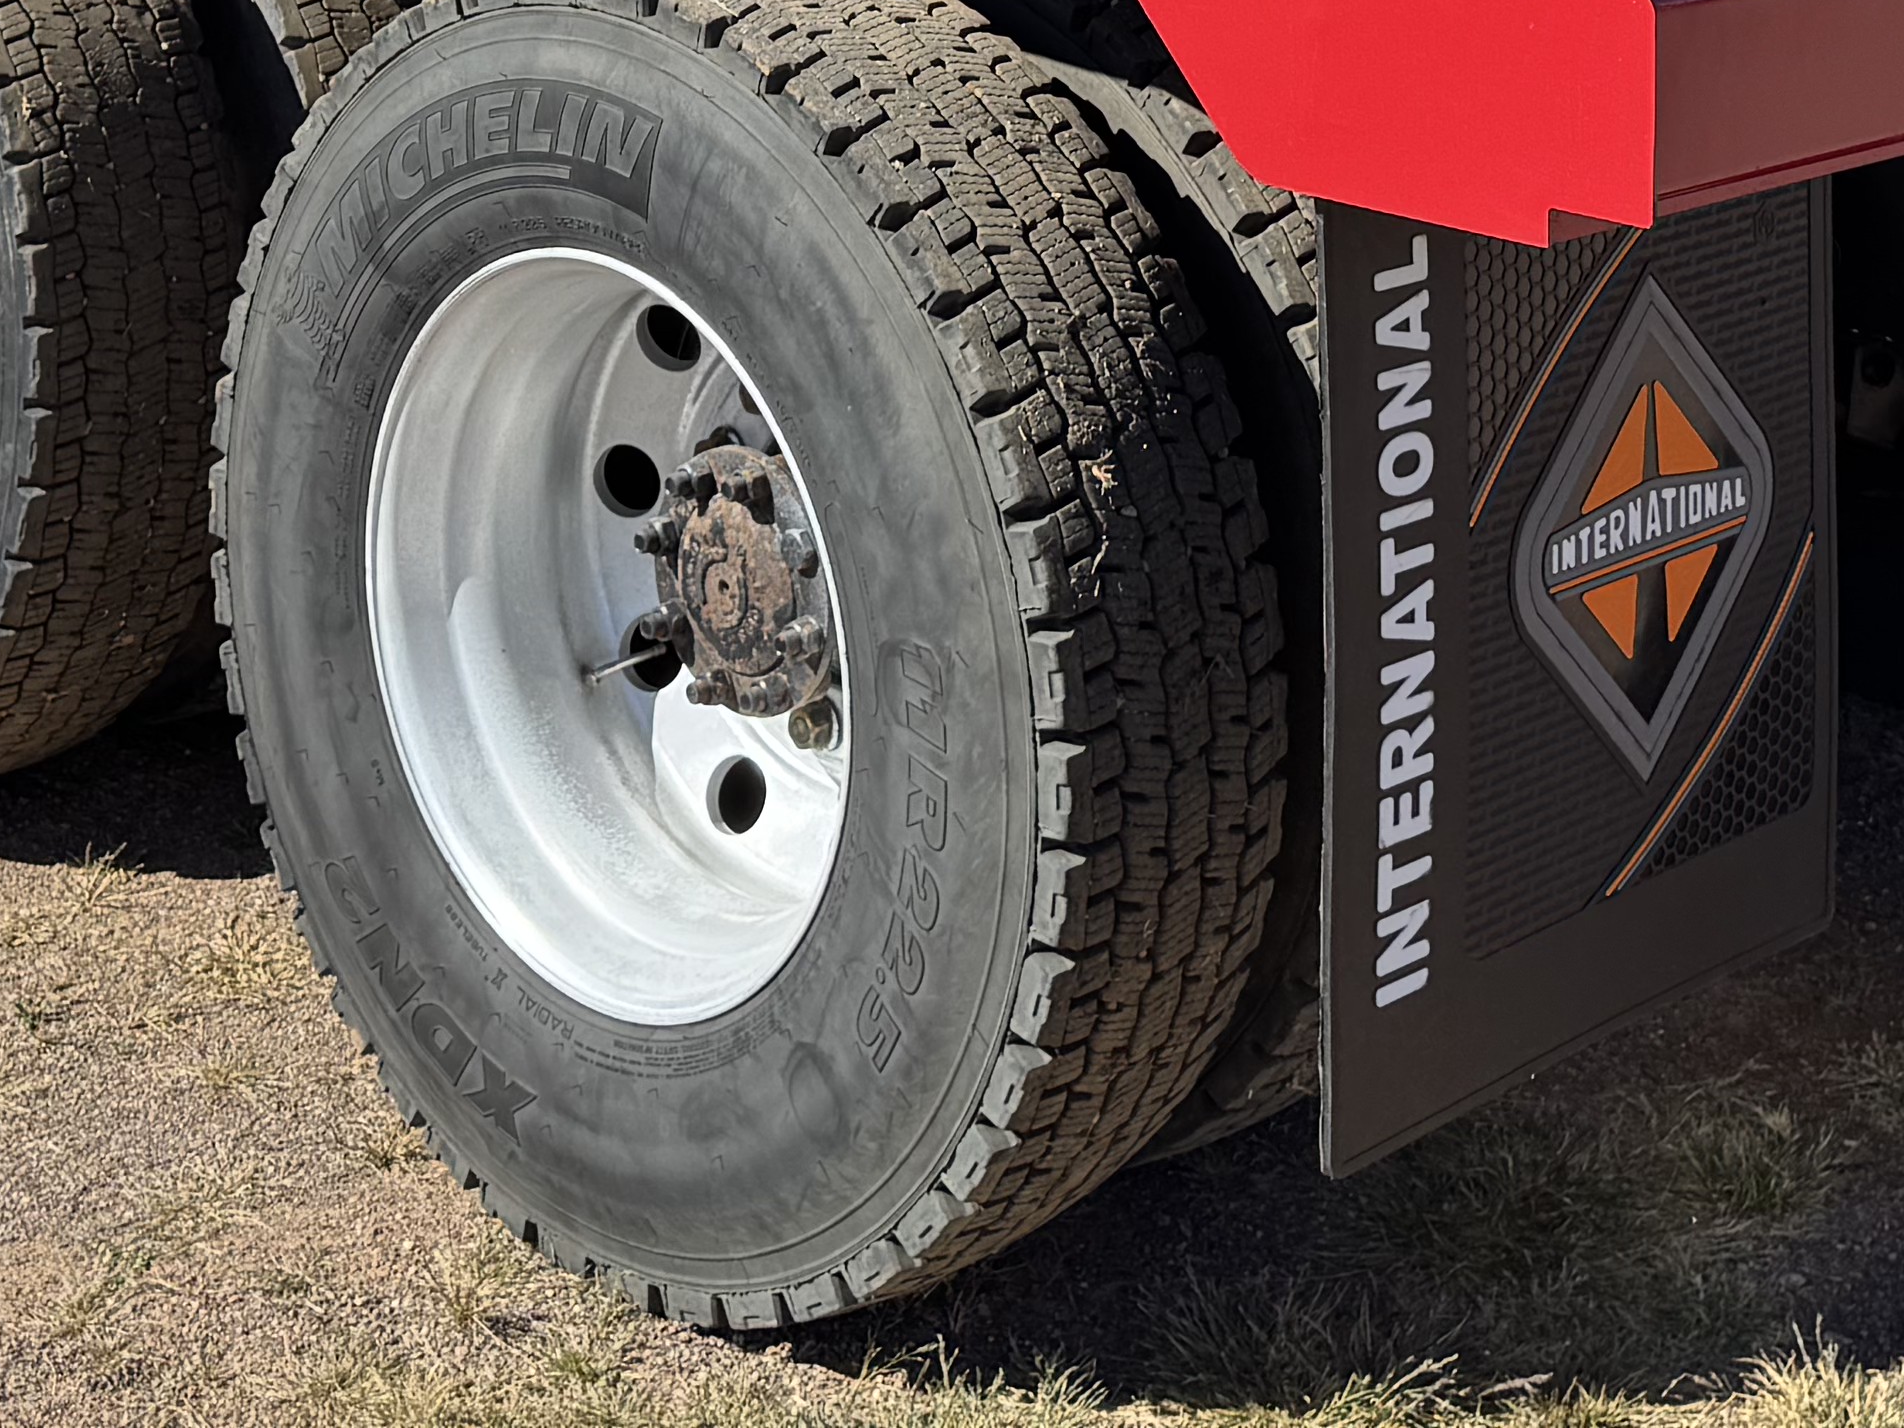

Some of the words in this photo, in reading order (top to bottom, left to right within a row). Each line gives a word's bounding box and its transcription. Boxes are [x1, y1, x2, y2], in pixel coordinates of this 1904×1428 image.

[314, 87, 657, 299] MICHELIN
[1551, 477, 1746, 575] INTERNATIONAL
[1374, 232, 1435, 1009] INTERNATIONAL
[516, 984, 576, 1040] RADIAL
